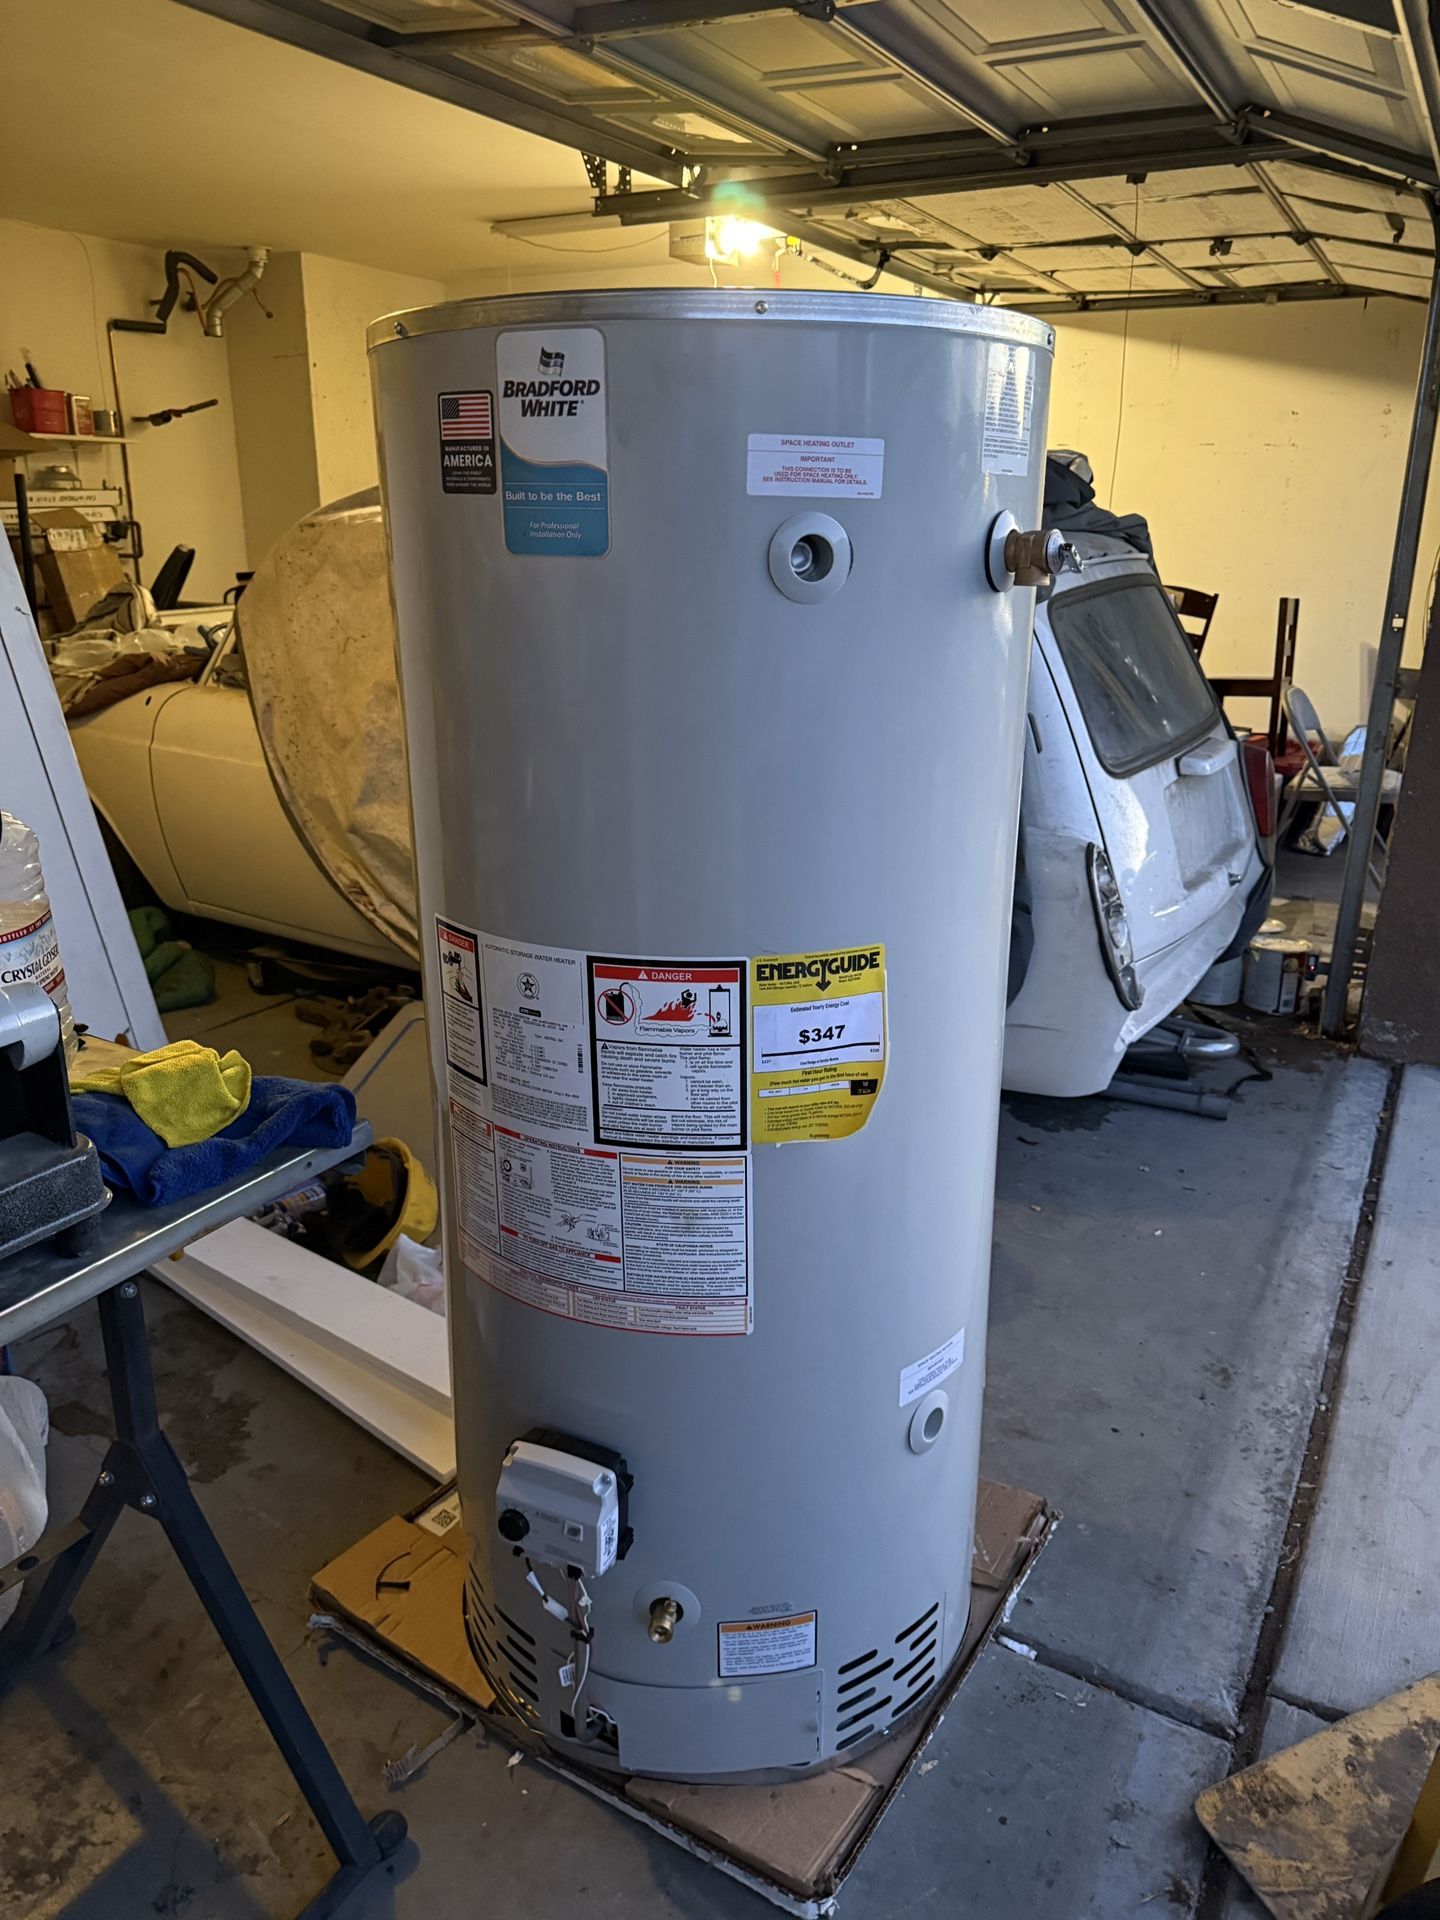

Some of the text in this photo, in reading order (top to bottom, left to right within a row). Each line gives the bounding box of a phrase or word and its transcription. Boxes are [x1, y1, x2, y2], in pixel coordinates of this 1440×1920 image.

[503, 380, 600, 398] BRADFORD
[521, 399, 579, 417] WHITE
[444, 454, 492, 466] AMERICA
[506, 491, 600, 501] Built to be the Best
[566, 530, 582, 540] Only
[448, 934, 468, 948] DANGER
[486, 944, 510, 954] AUTOMATIC
[510, 950, 533, 959] STORAGE
[1, 958, 42, 983] CRYSTAL
[756, 951, 880, 981] ENERGYGUIDE
[798, 1024, 846, 1045] $347
[752, 1620, 790, 1630] WARNING
